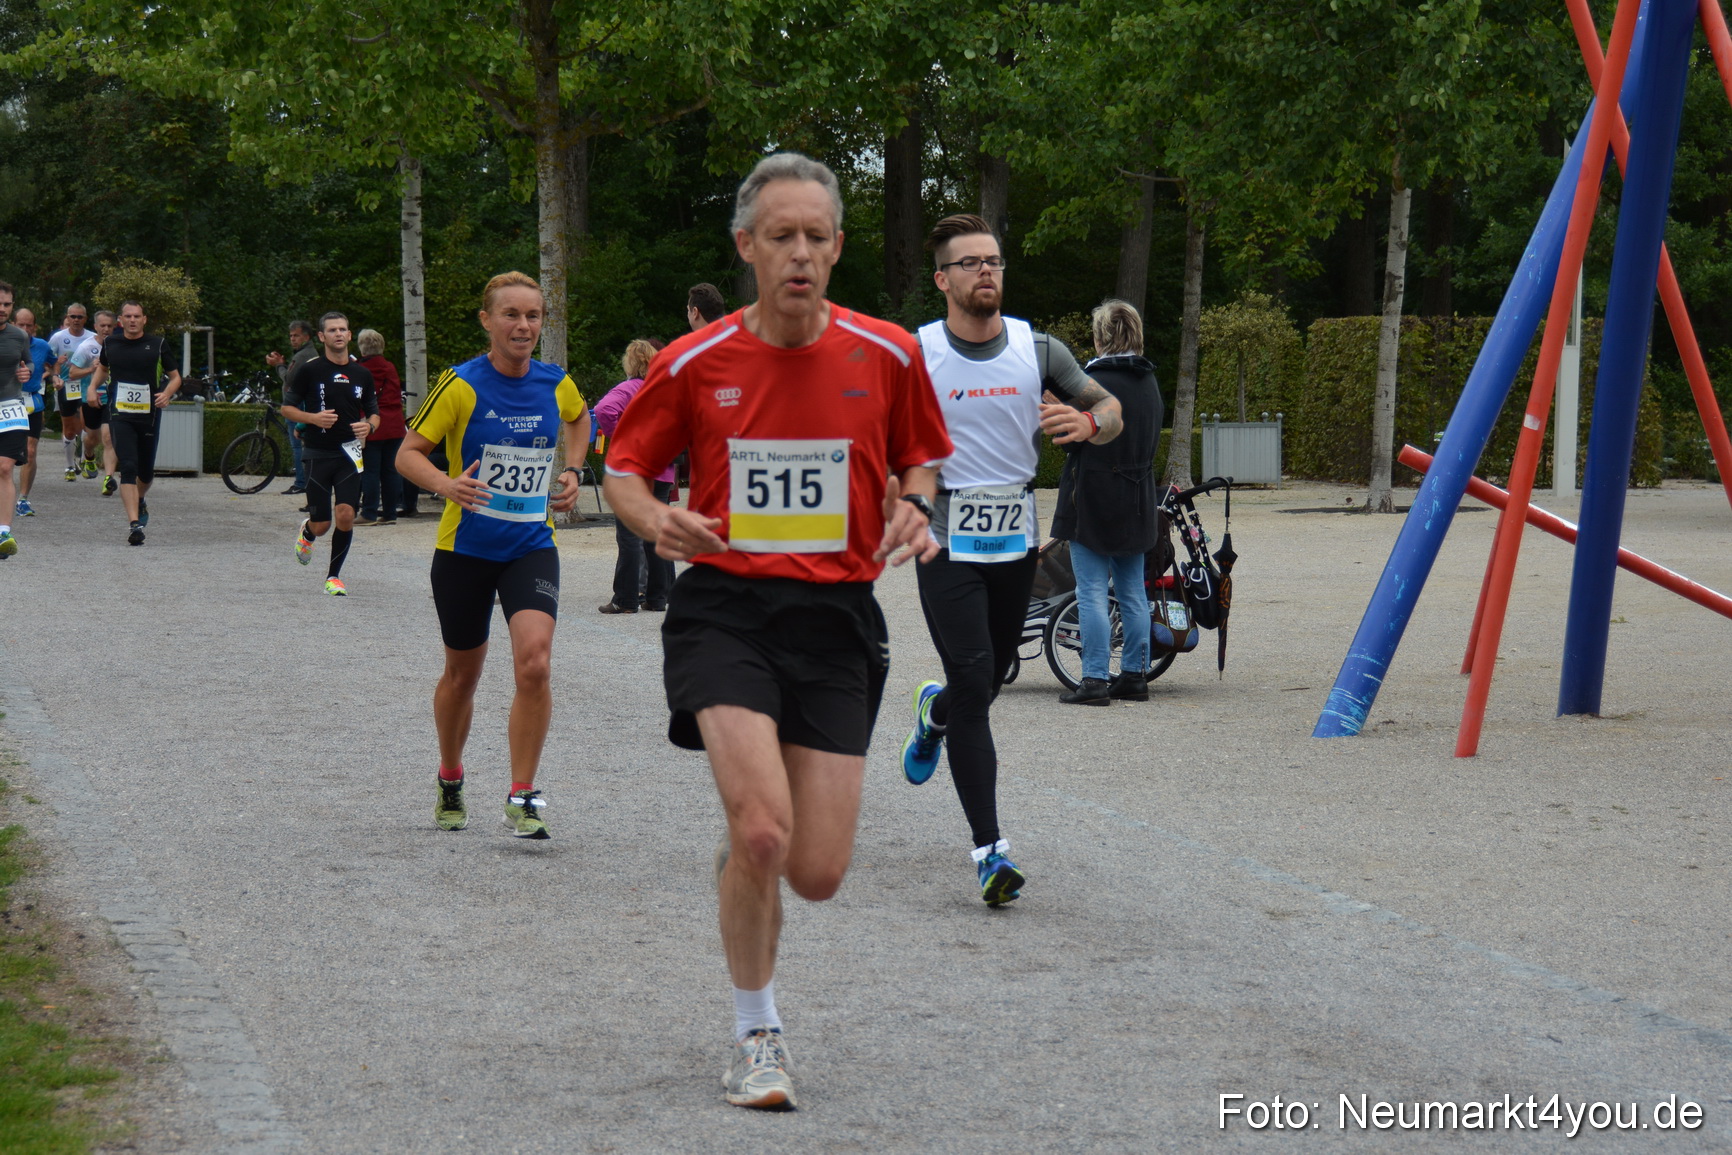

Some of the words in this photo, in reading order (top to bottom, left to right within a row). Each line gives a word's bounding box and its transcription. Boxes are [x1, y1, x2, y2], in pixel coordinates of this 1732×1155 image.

[70, 384, 80, 392] 51
[967, 387, 1022, 398] KLEBL
[127, 391, 142, 402] 32
[319, 383, 327, 433] BAVARA
[485, 451, 512, 461] PARTL
[513, 454, 544, 463] Neumarkt
[767, 452, 826, 462] Neumarkt
[487, 463, 547, 493] 2337
[747, 468, 823, 508] 515
[953, 492, 981, 500] PARTL
[982, 493, 1018, 501] Neumarkt
[506, 499, 525, 511] Eva
[958, 503, 1022, 532] 2572
[973, 539, 1006, 552] Daniel
